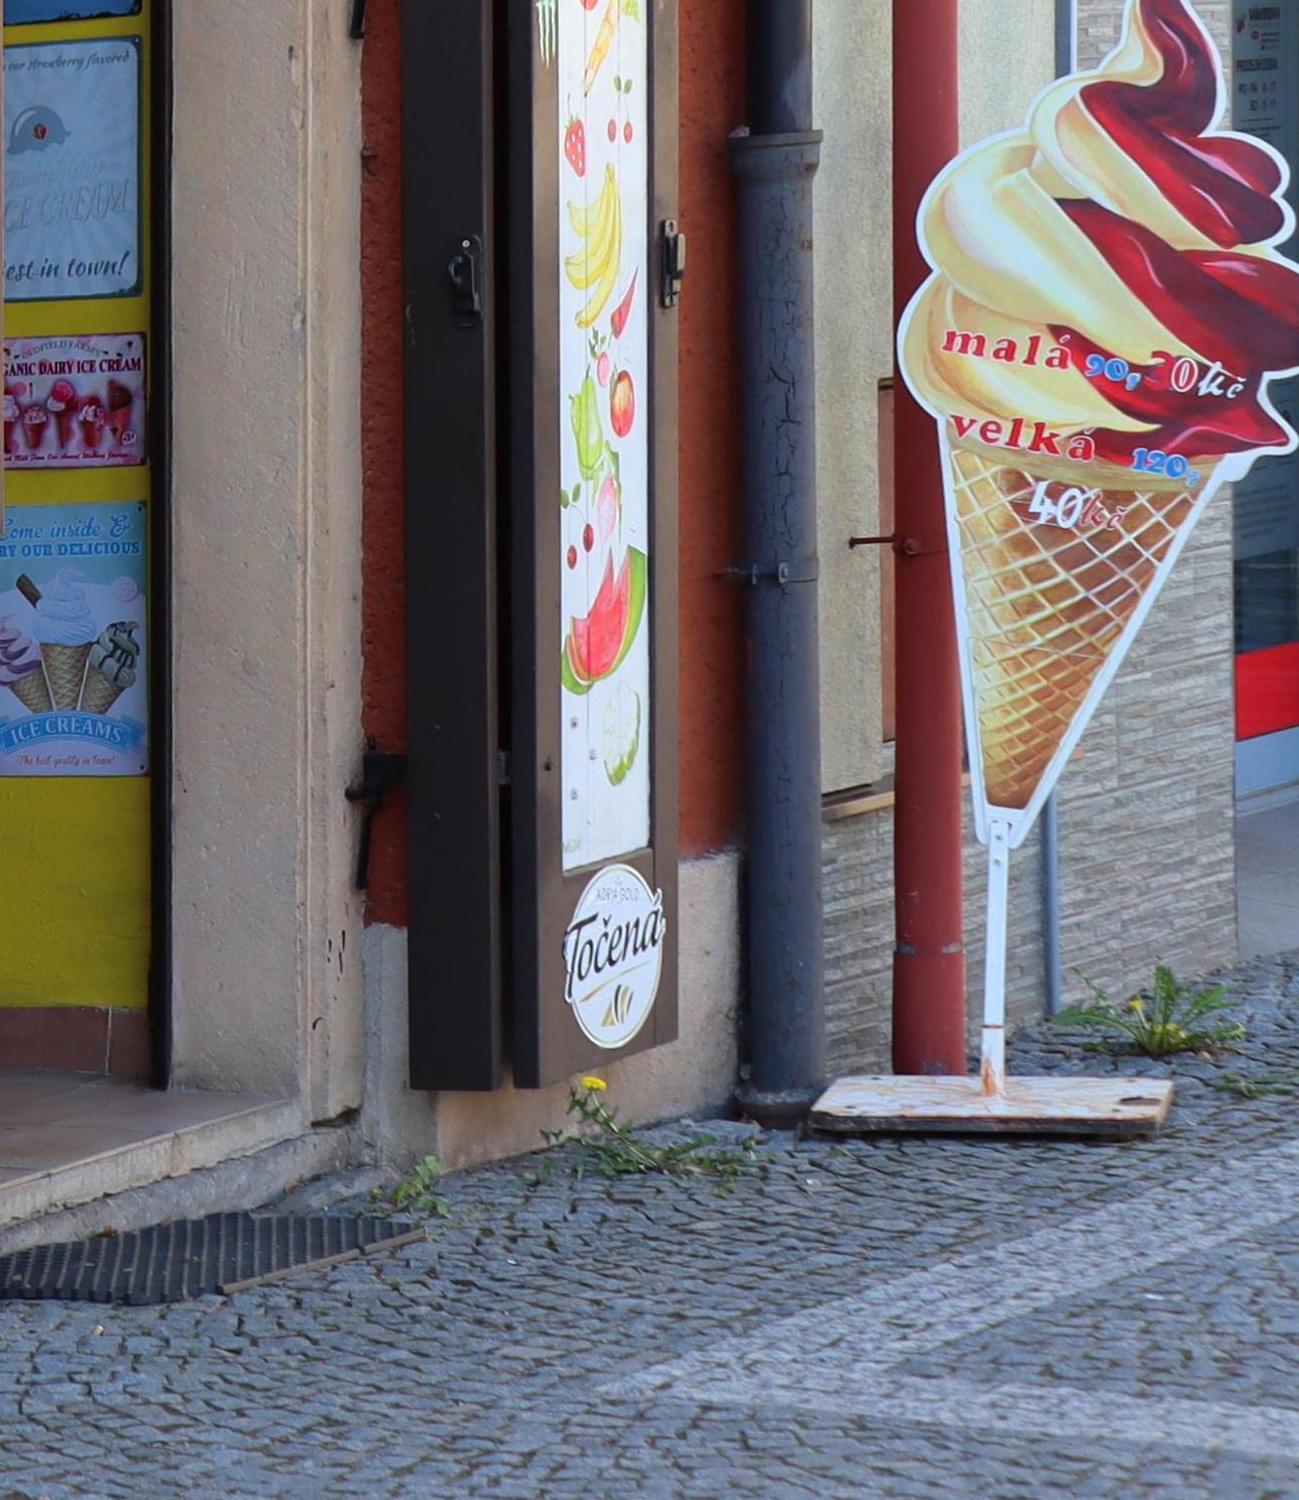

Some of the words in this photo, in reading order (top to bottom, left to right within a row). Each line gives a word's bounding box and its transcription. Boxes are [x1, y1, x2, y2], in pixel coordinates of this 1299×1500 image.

[4, 261, 34, 281] est
[67, 250, 131, 278] town!
[38, 360, 73, 376] DAIRY
[76, 360, 97, 374] ICE
[99, 357, 141, 372] CREAM
[941, 329, 1072, 370] malá
[1144, 350, 1199, 393] 30
[949, 414, 1096, 462] velká
[1028, 480, 1083, 529] 40
[50, 516, 101, 538] inside
[22, 543, 52, 558] OUR
[57, 541, 140, 556] DELICIOUS
[10, 722, 42, 744] ICE
[45, 716, 124, 743] CREAMS
[563, 890, 663, 998] Točená
